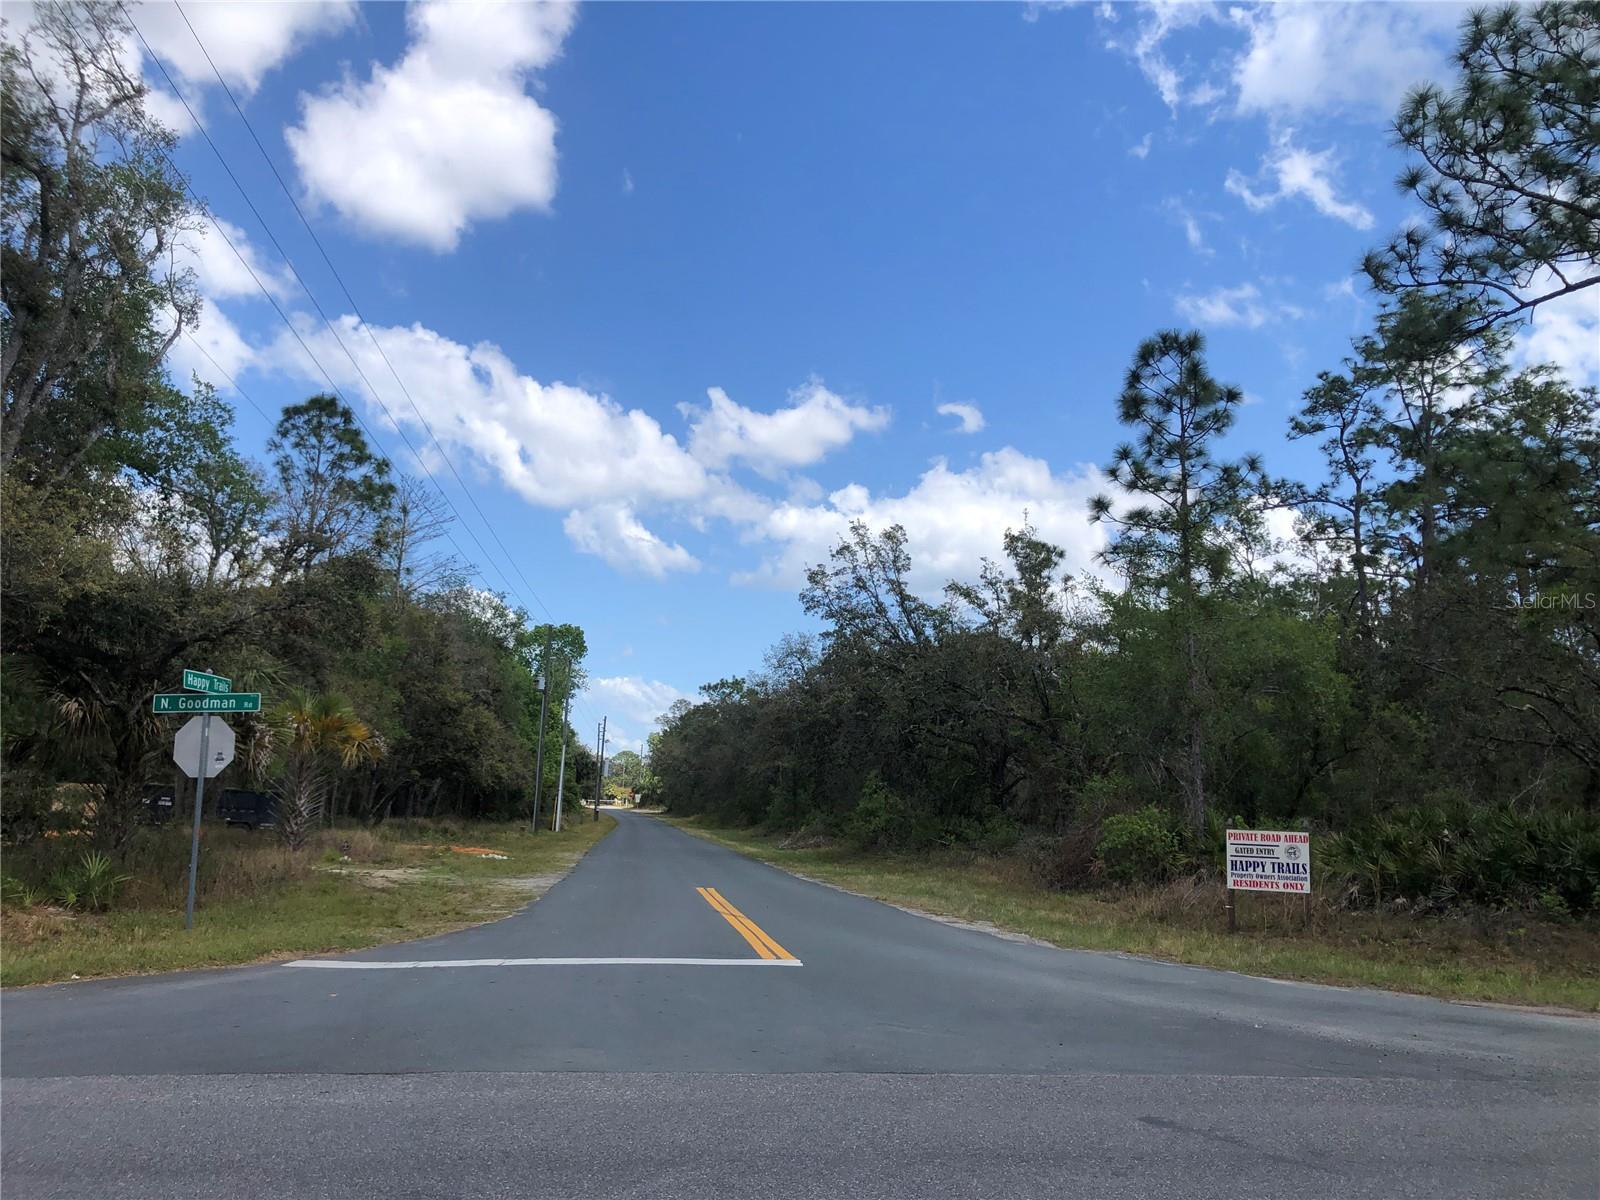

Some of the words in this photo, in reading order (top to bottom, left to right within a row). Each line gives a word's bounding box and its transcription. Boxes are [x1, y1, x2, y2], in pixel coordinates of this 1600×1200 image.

[187, 674, 210, 690] Happy
[214, 680, 229, 692] Trails
[160, 698, 172, 709] N.
[179, 698, 236, 709] Goodman
[1228, 832, 1259, 842] PRIVATE
[1260, 834, 1281, 842] ROAD
[1283, 835, 1309, 844] AHEAD
[1234, 847, 1255, 855] GATED
[1256, 848, 1276, 856] ENTRY
[1230, 860, 1267, 873] HAPPY
[1270, 862, 1308, 875] TRAILS
[1232, 879, 1280, 890] RESIDENTS
[1282, 882, 1305, 891] ONLY
